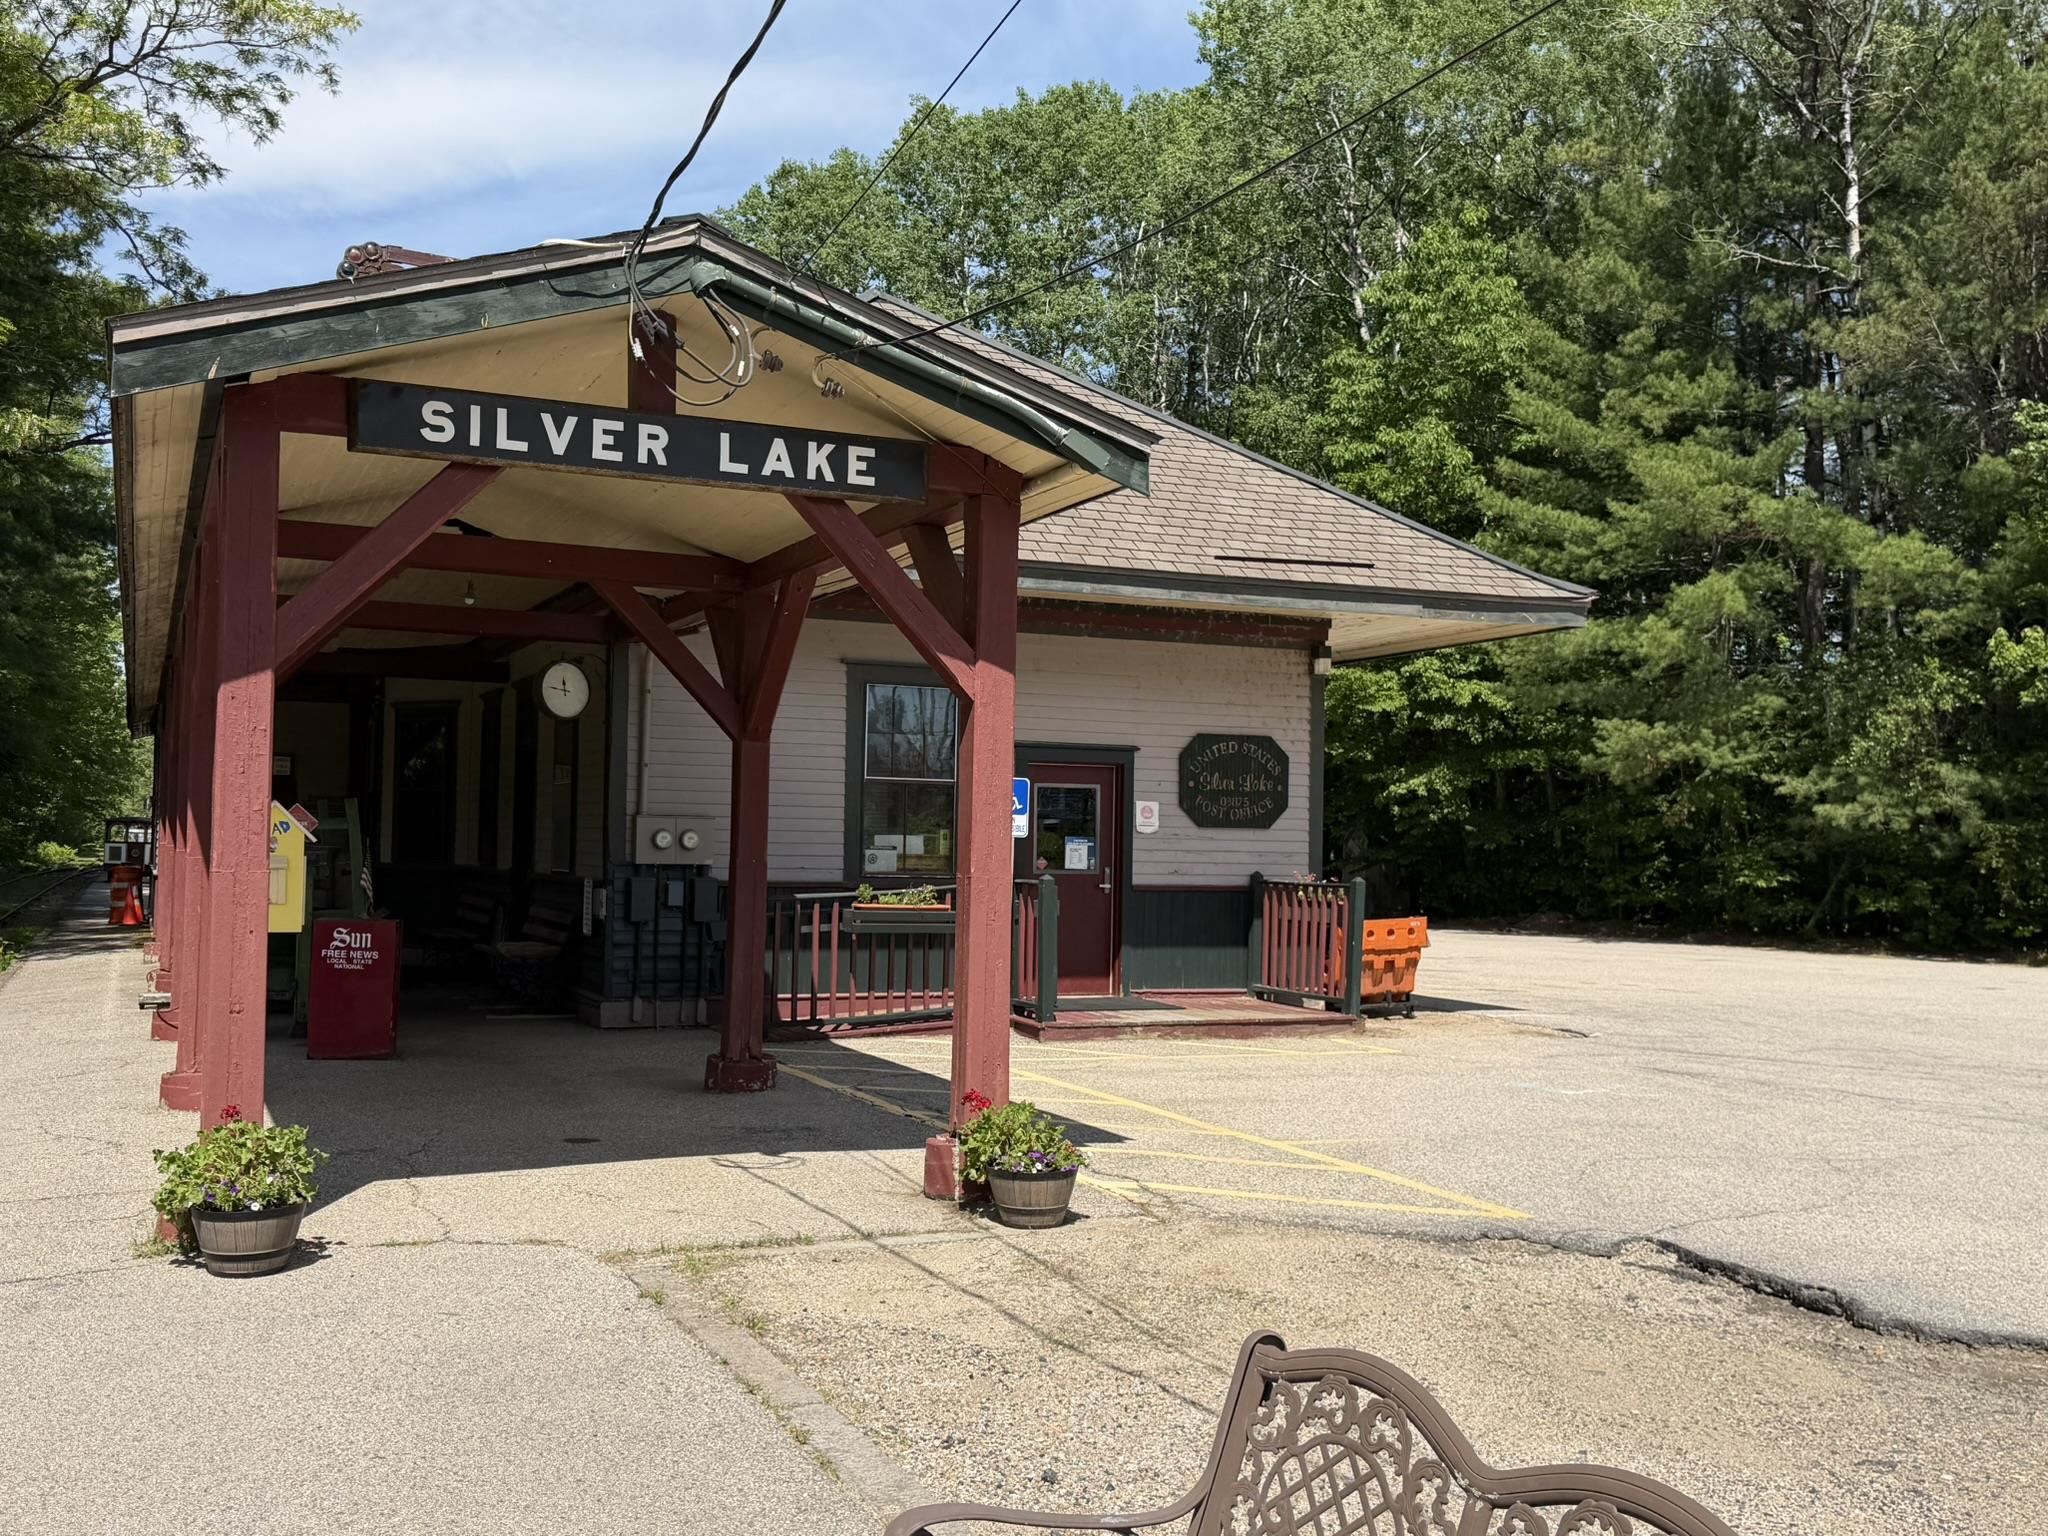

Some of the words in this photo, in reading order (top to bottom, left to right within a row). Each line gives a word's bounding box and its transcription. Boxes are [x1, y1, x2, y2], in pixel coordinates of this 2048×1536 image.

[419, 400, 668, 466] SILVER
[719, 432, 877, 487] LAKE
[1190, 741, 1238, 774] UNITED
[1241, 742, 1281, 776] STATES
[1195, 795, 1227, 819] POST
[1230, 797, 1274, 821] OFFICE
[329, 927, 372, 949] Sun
[321, 949, 348, 958] FREE
[349, 950, 379, 959] NEWS
